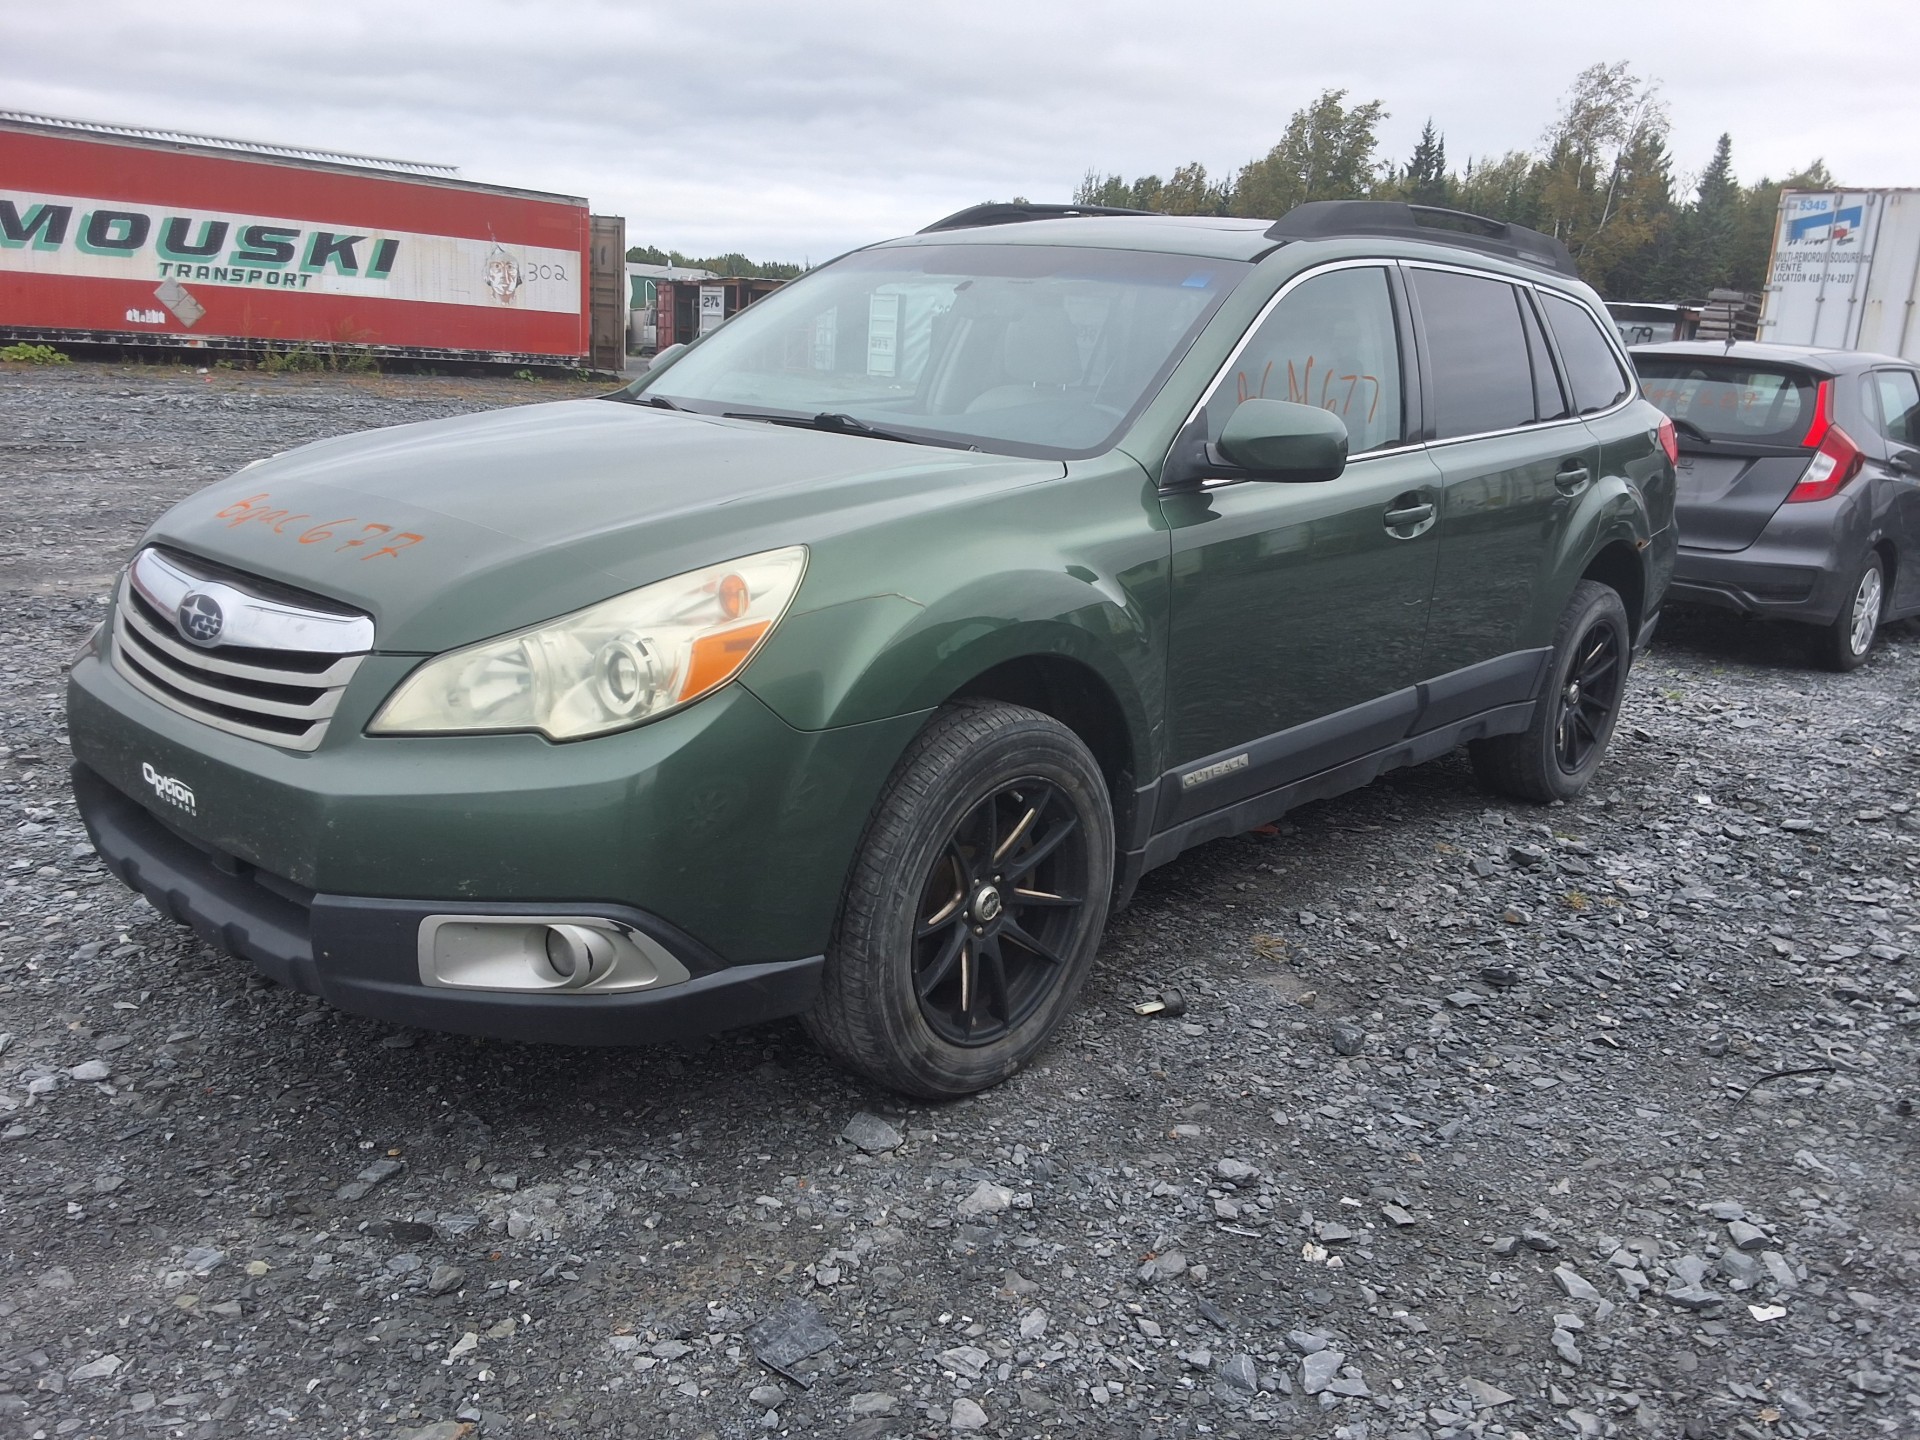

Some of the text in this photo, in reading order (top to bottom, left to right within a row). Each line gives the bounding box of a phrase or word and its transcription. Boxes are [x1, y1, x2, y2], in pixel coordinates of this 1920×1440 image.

[1800, 200, 1828, 211] 5345
[0, 200, 400, 278] MOUSKI
[1775, 251, 1829, 263] MULTI-REMORQU
[159, 262, 312, 288] TRANSPORT
[527, 262, 568, 281] 302
[1775, 263, 1802, 272] VENTE
[1773, 273, 1854, 284] LOCATION 418-74-2037
[142, 761, 196, 808] Option
